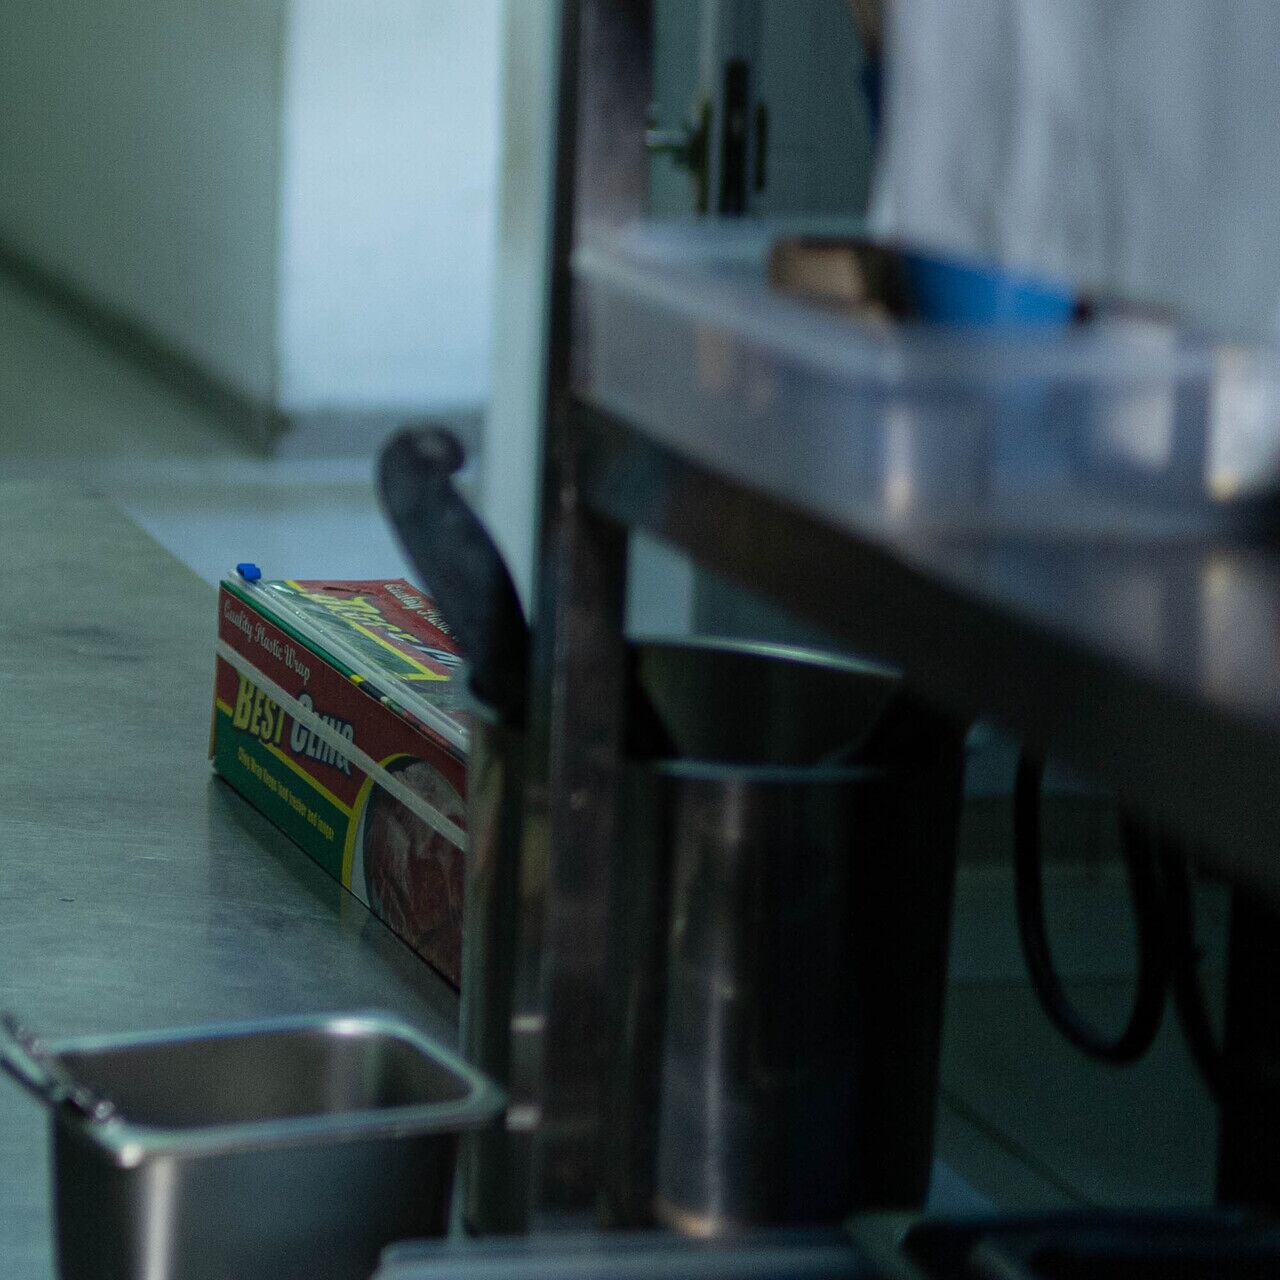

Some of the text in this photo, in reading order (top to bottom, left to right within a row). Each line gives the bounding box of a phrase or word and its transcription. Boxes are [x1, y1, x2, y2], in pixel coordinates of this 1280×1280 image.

[224, 599, 253, 642] Quality
[255, 622, 284, 662] Plastic
[284, 645, 311, 686] Wrap
[233, 671, 287, 744] BEST
